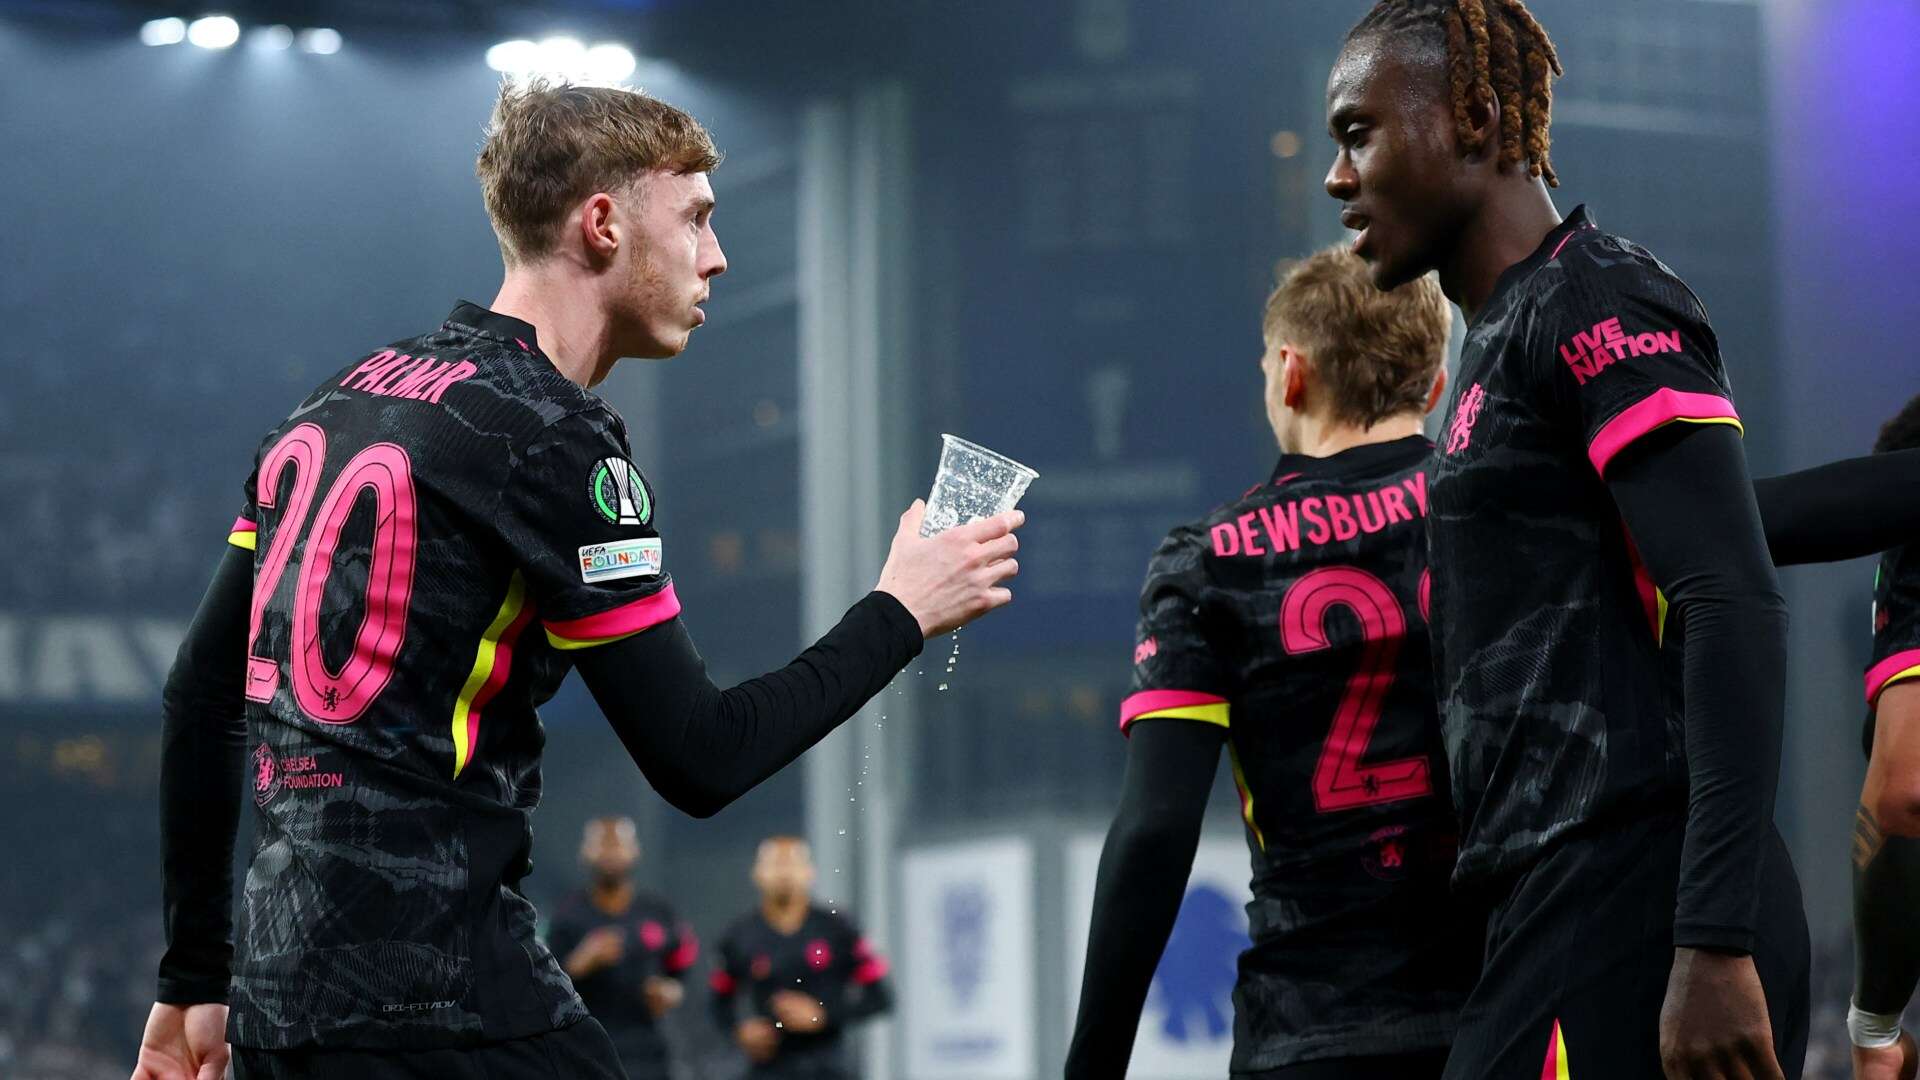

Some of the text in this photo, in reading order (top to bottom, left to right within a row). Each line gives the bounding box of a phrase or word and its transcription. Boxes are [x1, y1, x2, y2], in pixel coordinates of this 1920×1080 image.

[1560, 317, 1625, 365] LIVE
[1570, 330, 1682, 385] NATION
[339, 350, 477, 404] PALMER
[245, 422, 417, 725] 20
[582, 546, 606, 557] UEFA
[1280, 565, 1432, 813] 2
[281, 756, 317, 771] CHELSEA
[282, 773, 343, 789] FOUNDATION
